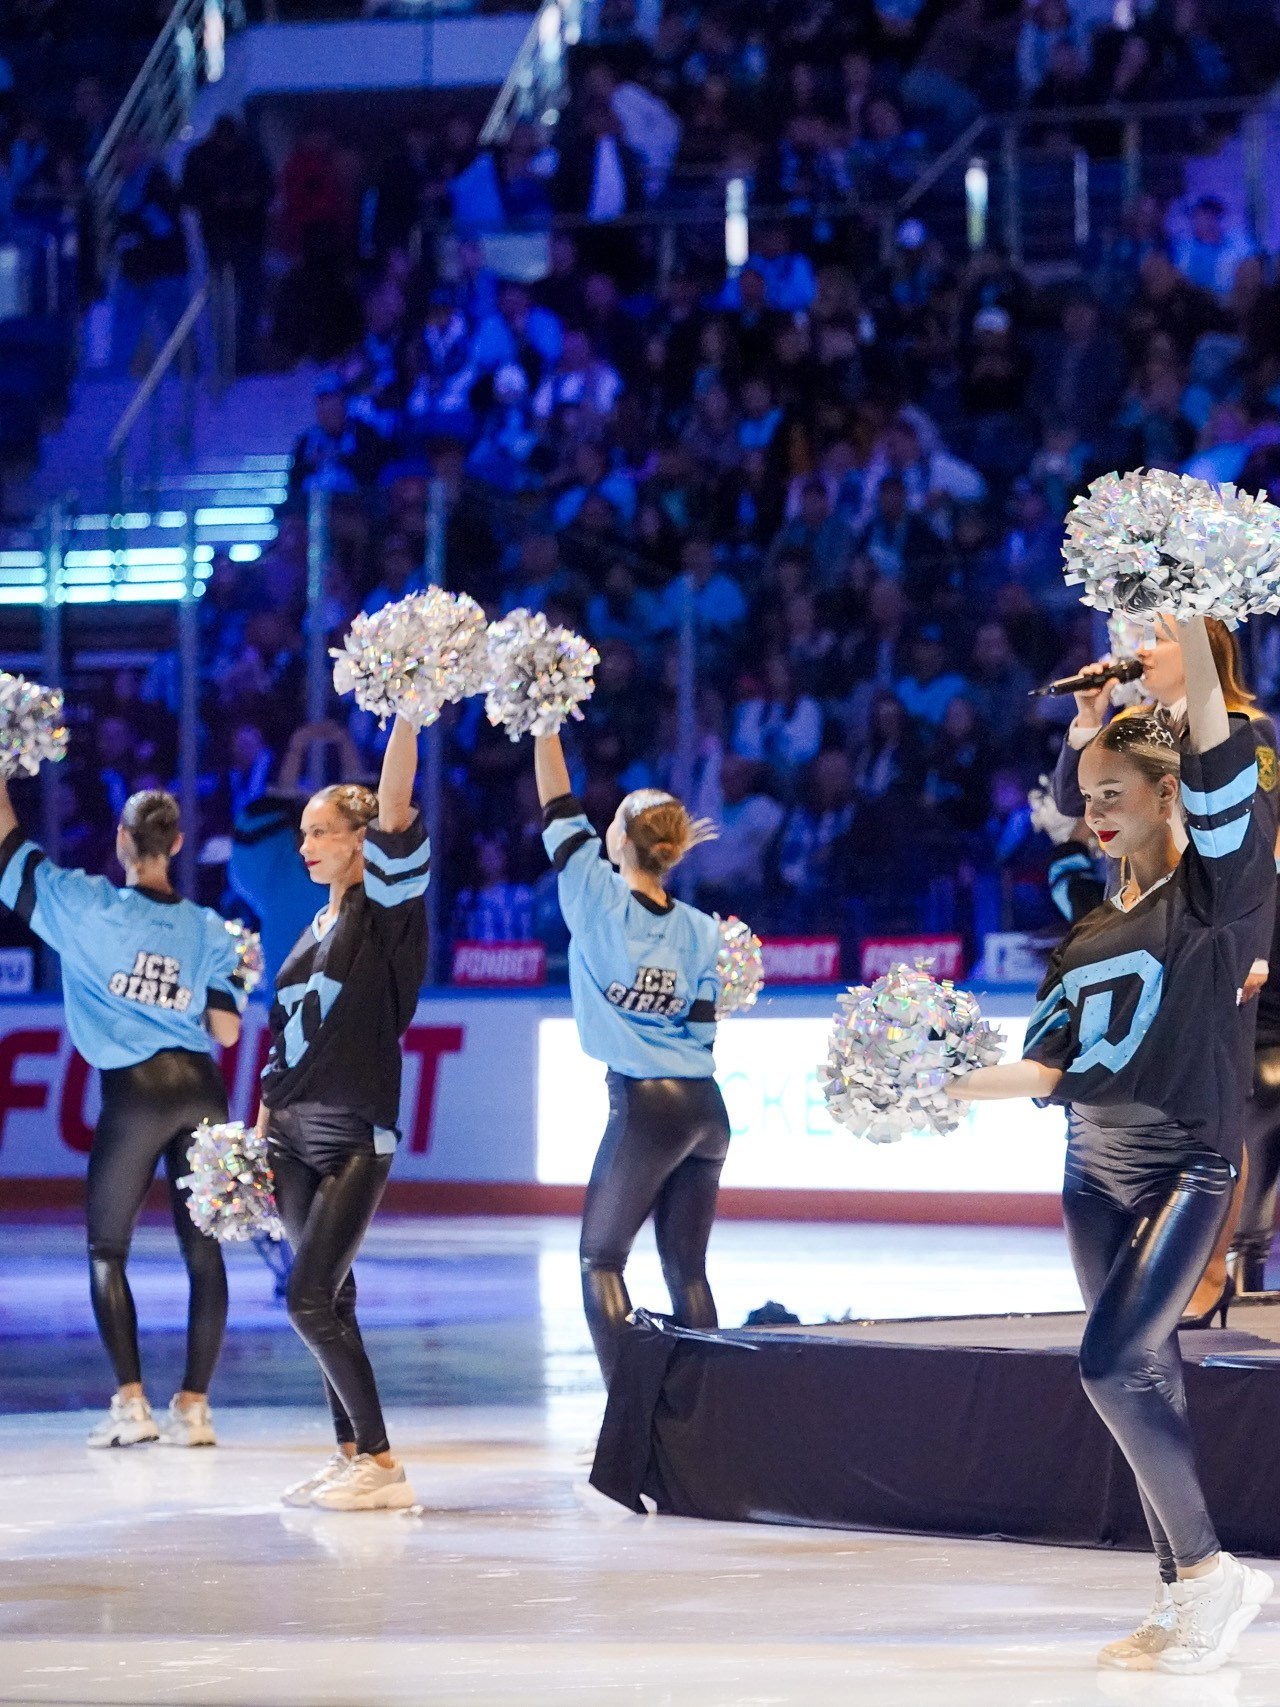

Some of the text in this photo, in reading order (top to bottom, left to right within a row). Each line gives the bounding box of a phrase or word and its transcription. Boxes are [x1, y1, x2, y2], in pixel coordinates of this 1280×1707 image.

[131, 950, 181, 984] ICE
[632, 966, 678, 996] ICE
[108, 970, 193, 1012] GIRLS
[603, 980, 689, 1018] GIRLS
